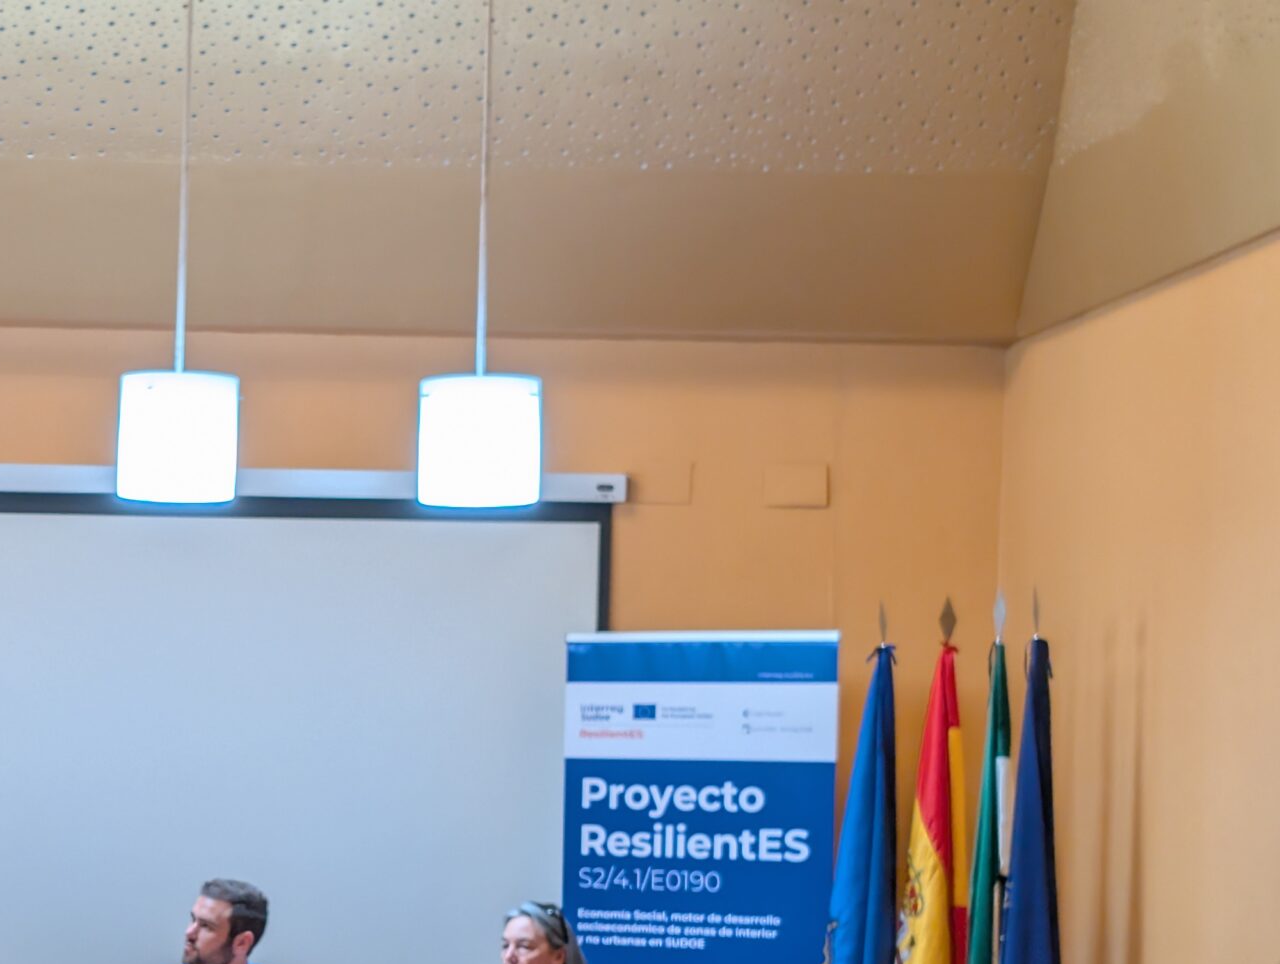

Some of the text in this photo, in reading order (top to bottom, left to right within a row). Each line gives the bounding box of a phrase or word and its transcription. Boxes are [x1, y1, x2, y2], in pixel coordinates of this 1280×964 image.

[581, 777, 766, 820] Proyecto
[580, 823, 811, 862] ResilientES
[578, 866, 721, 893] S2/4.1/E0190
[634, 909, 668, 923] Social,
[670, 912, 704, 924] motor
[706, 912, 722, 924] de
[724, 913, 781, 926] desarrollo
[585, 934, 600, 945] no
[602, 934, 646, 947] urbanas
[648, 937, 662, 948] en
[666, 923, 682, 936] de
[684, 926, 716, 938] zonas
[718, 926, 733, 938] de
[735, 926, 778, 939] interior
